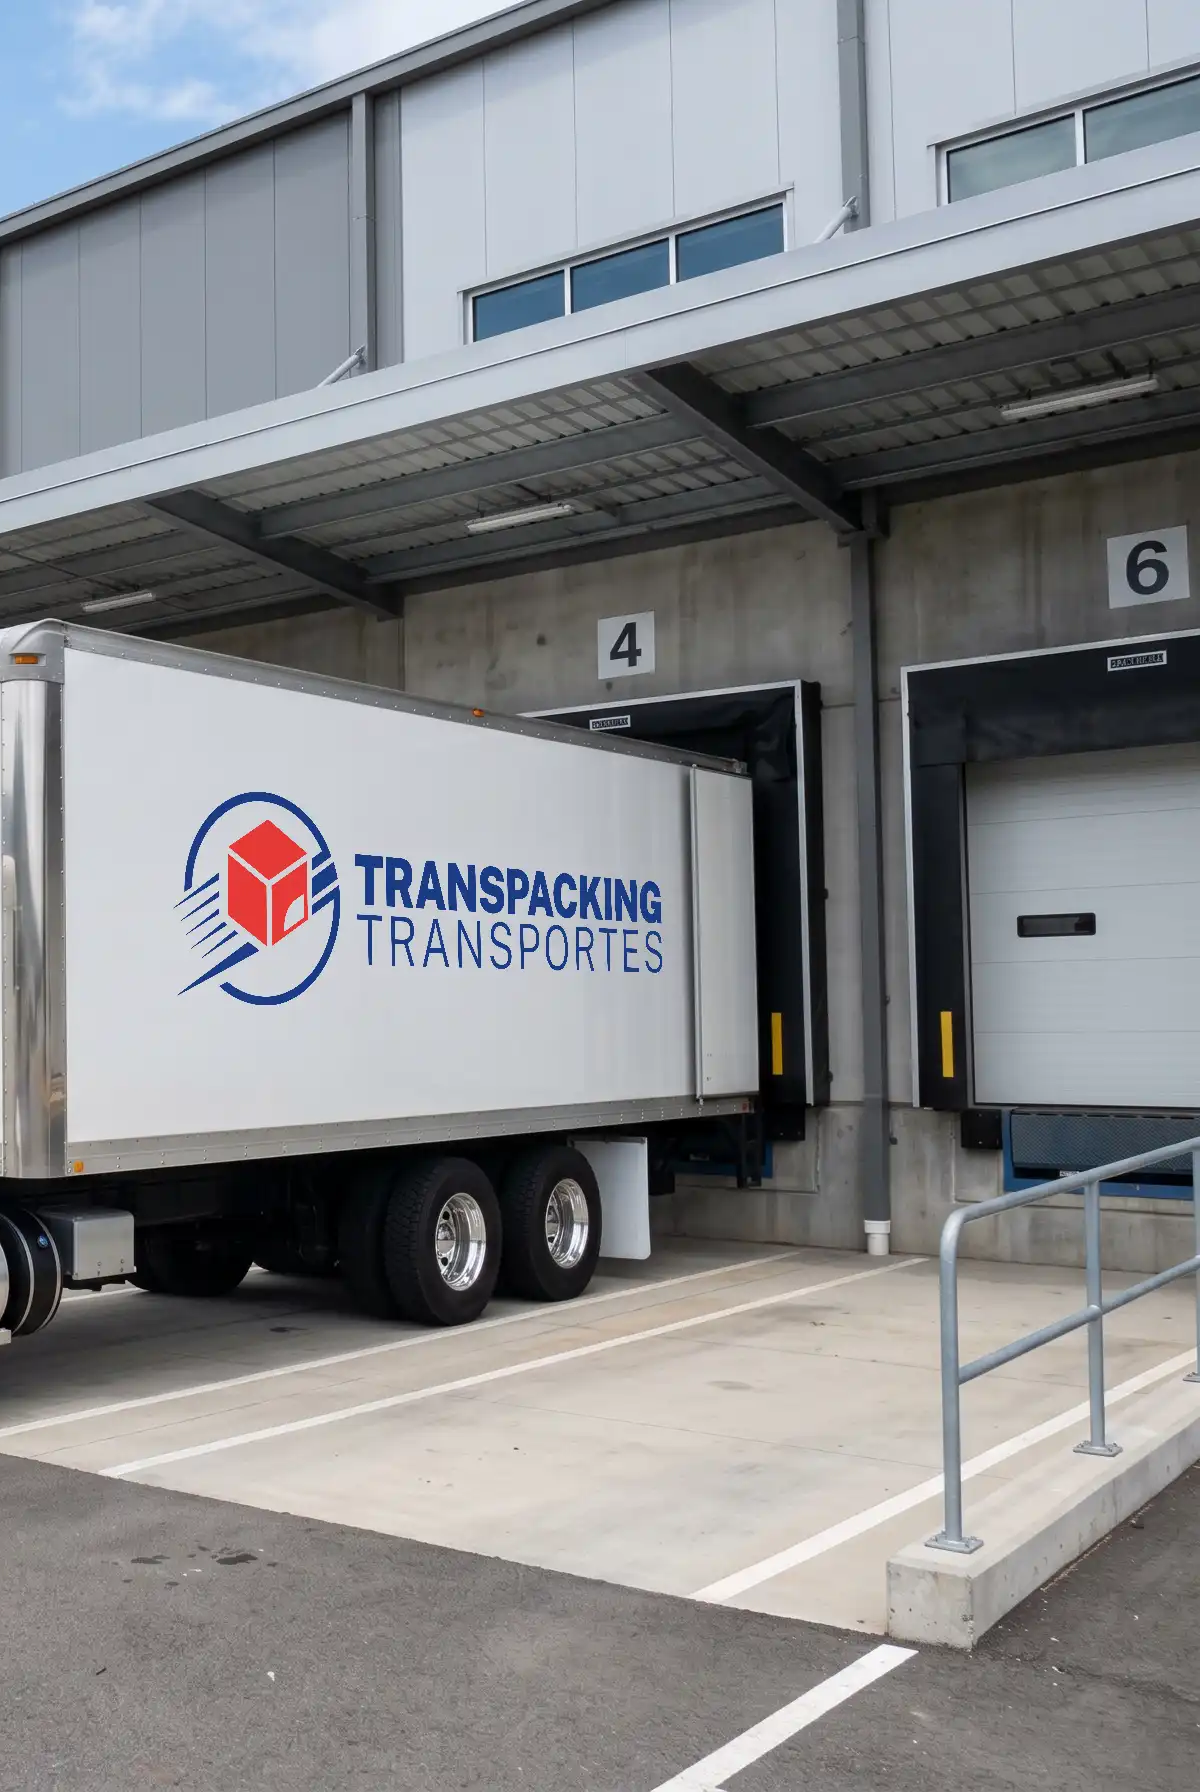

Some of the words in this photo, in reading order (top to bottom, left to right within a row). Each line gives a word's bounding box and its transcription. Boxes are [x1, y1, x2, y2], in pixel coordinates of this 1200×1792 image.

[1125, 541, 1169, 595] 6
[609, 621, 642, 667] 4
[354, 854, 662, 925] TRANSPACKING
[356, 913, 663, 973] TRANSPORTES
